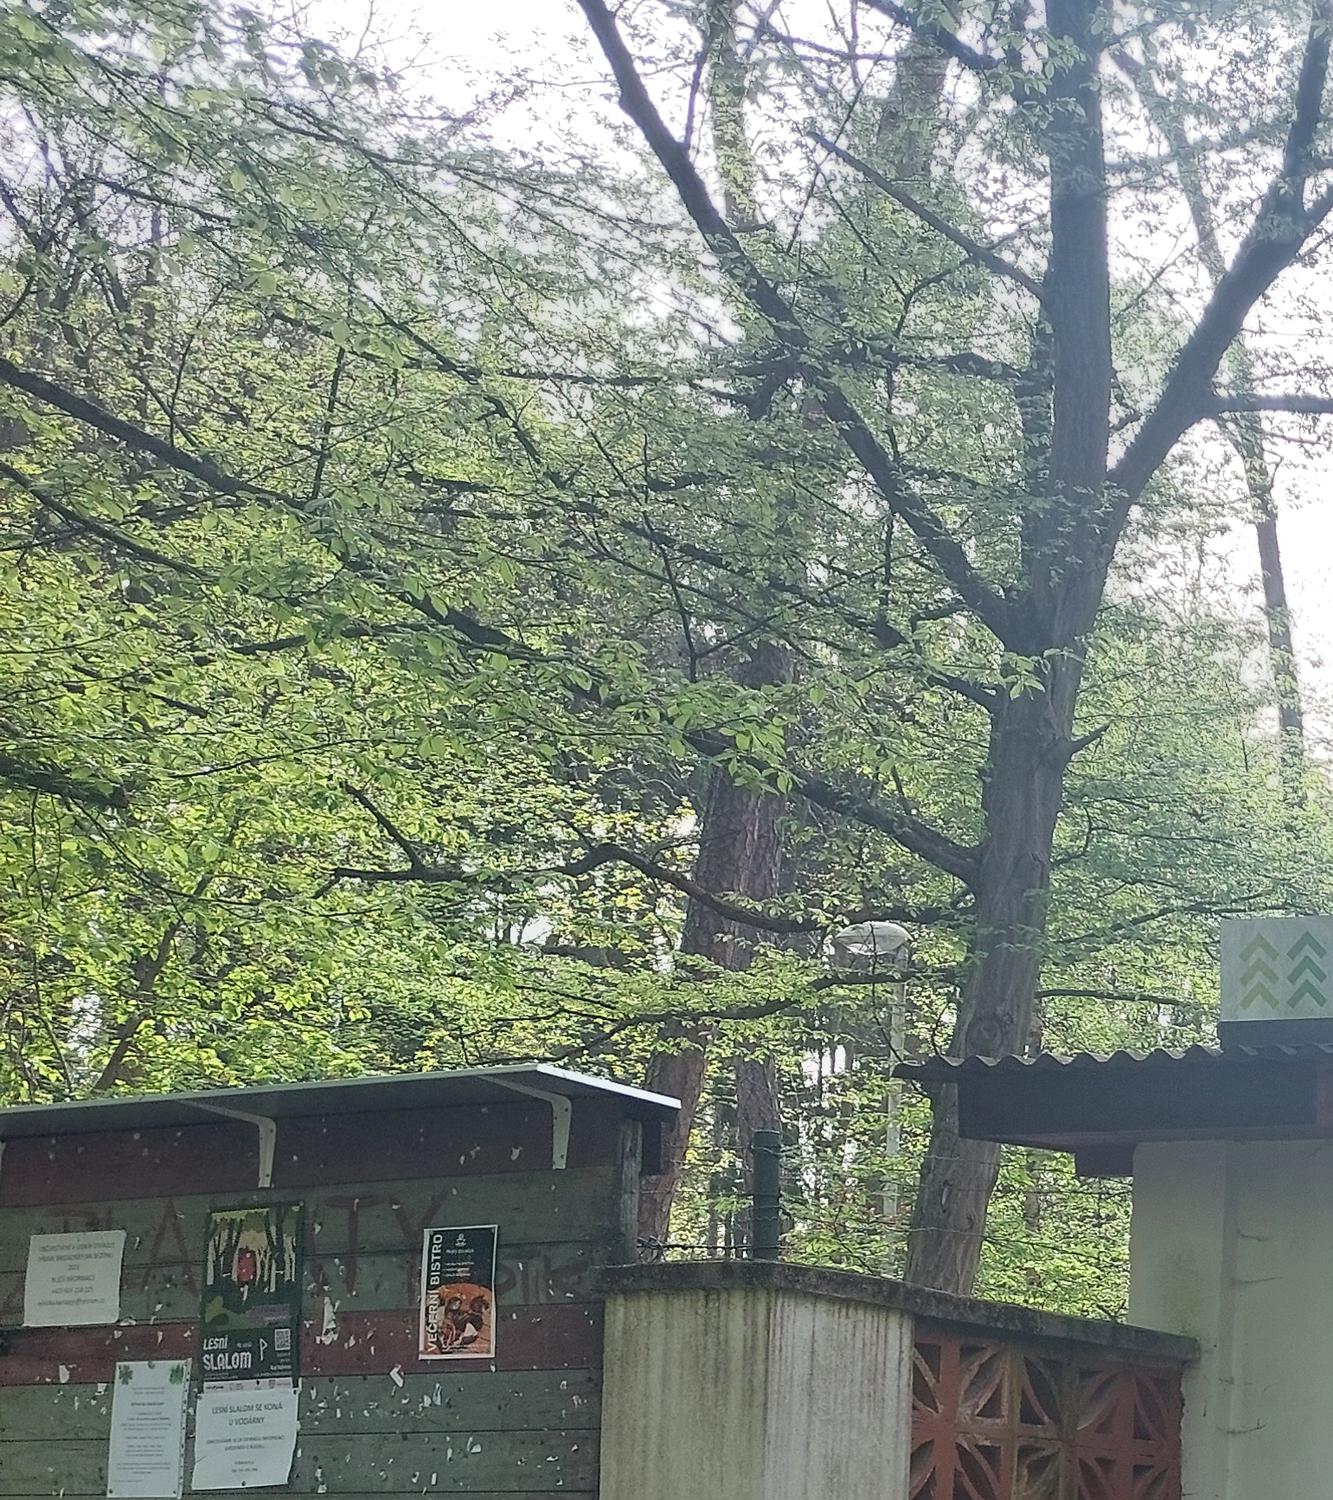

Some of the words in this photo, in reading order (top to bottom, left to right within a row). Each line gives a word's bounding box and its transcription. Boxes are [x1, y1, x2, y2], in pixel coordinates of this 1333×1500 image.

[430, 1233, 443, 1286] BISTRO
[425, 1290, 440, 1352] VEČERNÍ
[202, 1351, 252, 1371] SLALOM
